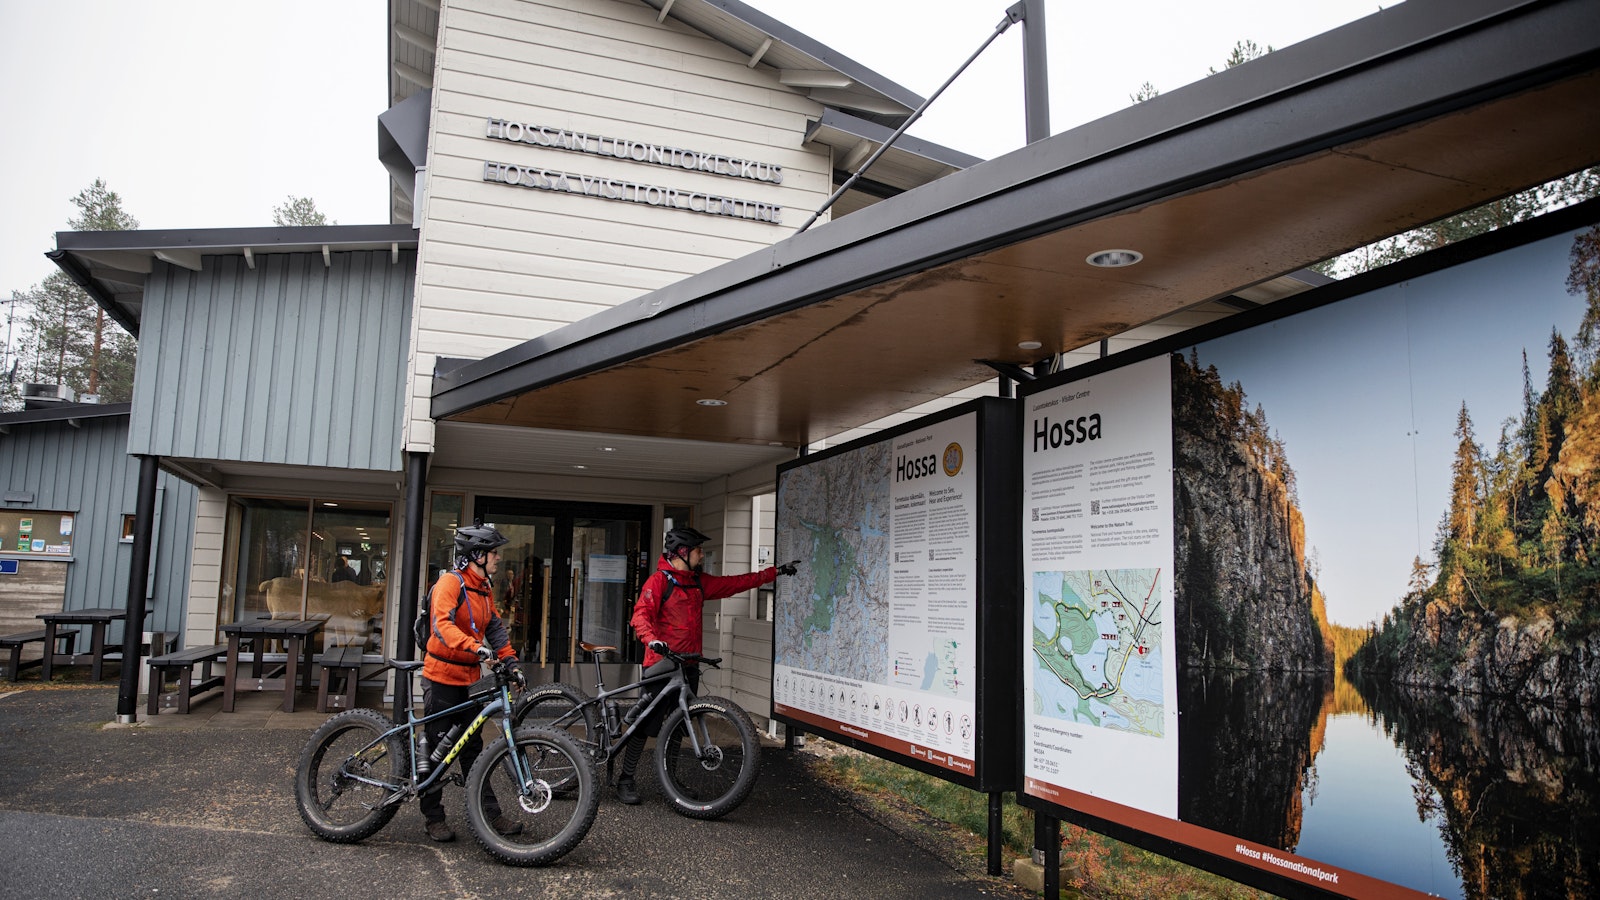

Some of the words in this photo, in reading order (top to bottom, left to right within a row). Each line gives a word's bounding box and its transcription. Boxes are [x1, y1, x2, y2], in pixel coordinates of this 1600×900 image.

[486, 116, 588, 152] HOSSAN
[598, 134, 784, 185] LUONTOKESKUS
[483, 160, 571, 193] HOSSA
[580, 173, 679, 208] VISITOR
[688, 192, 783, 225] CENTRE
[1061, 394, 1076, 403] Visitor
[1076, 390, 1090, 398] Centre
[1033, 413, 1102, 453] Hossa
[896, 454, 937, 482] Hossa
[526, 689, 562, 702] BONTRAGER
[688, 703, 726, 713] BONTRAGER
[1235, 844, 1261, 859] #Hossa
[1262, 852, 1339, 884] #Hossanationalpark
